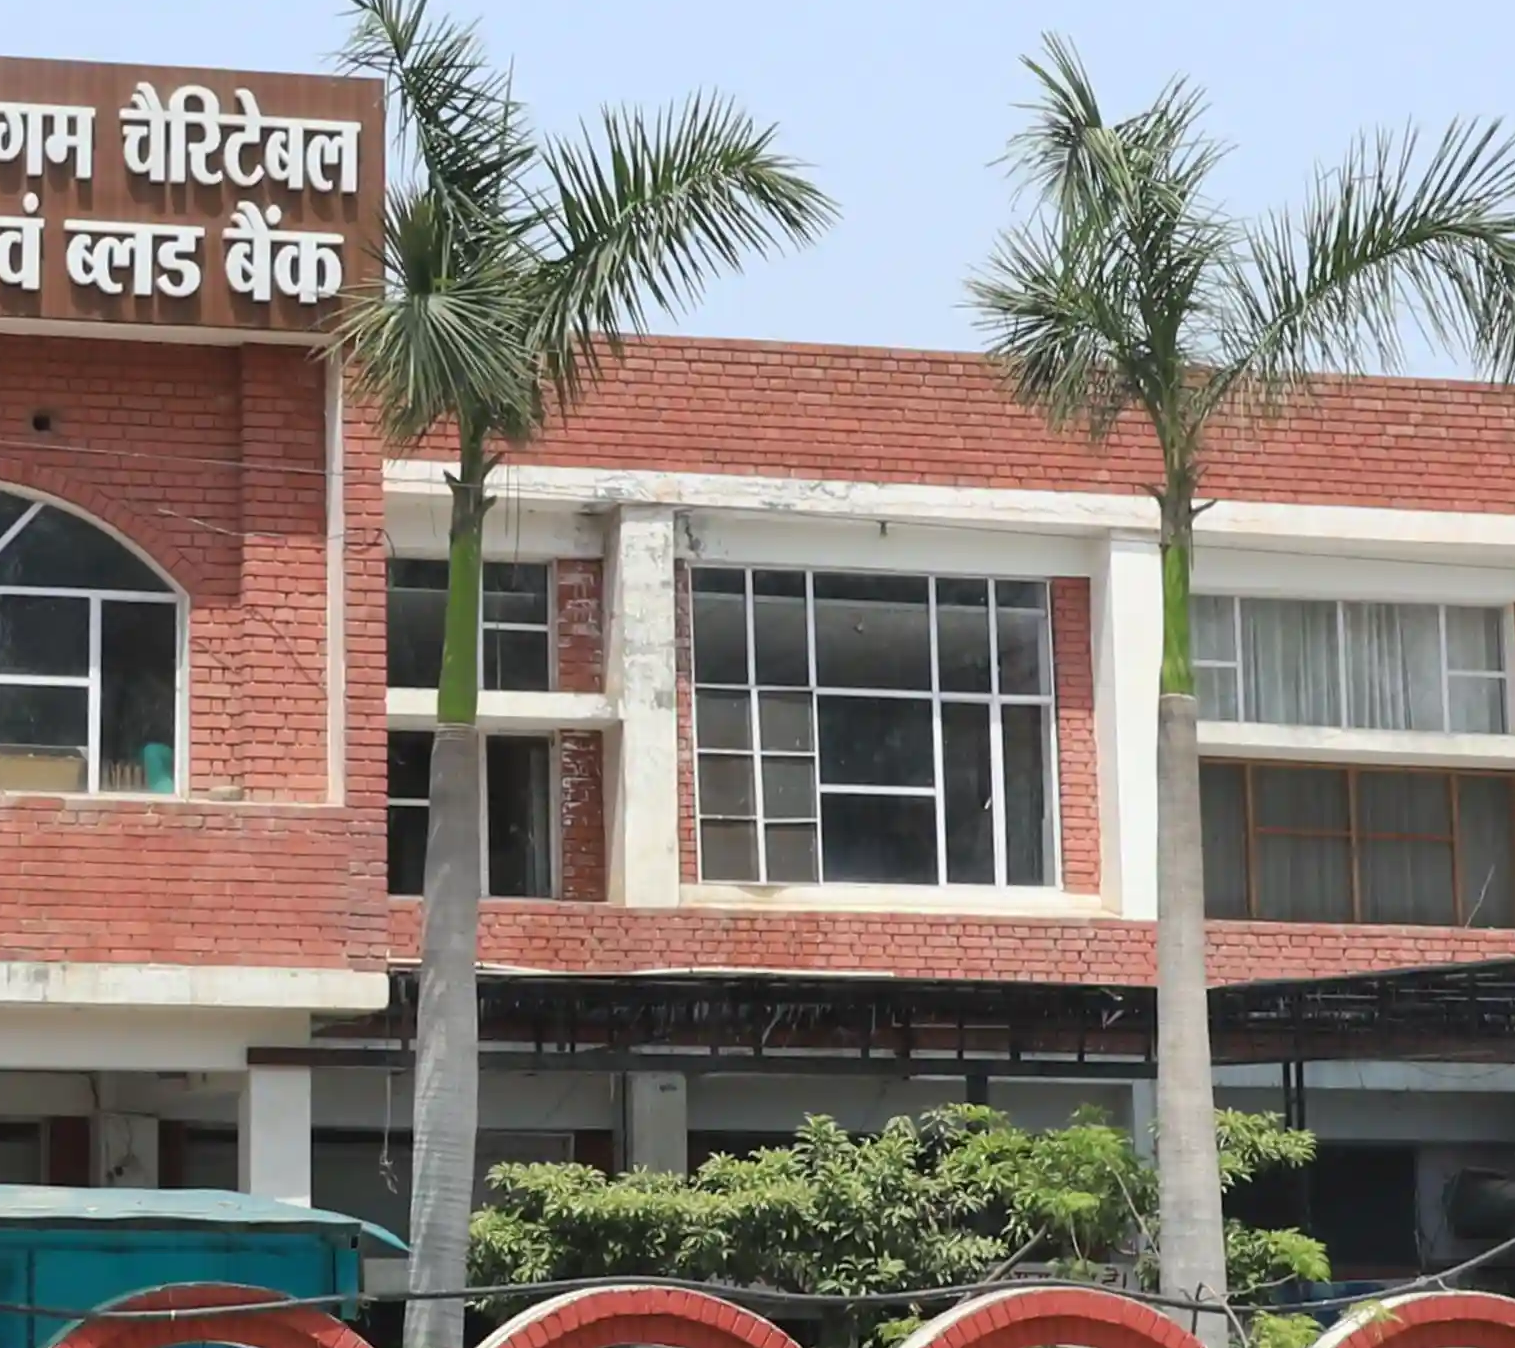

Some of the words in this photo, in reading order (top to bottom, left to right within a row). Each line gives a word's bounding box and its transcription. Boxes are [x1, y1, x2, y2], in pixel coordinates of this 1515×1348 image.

[121, 82, 360, 193] चैरिटेबल
[65, 219, 204, 297] ब्लड
[223, 201, 344, 303] बैंक
